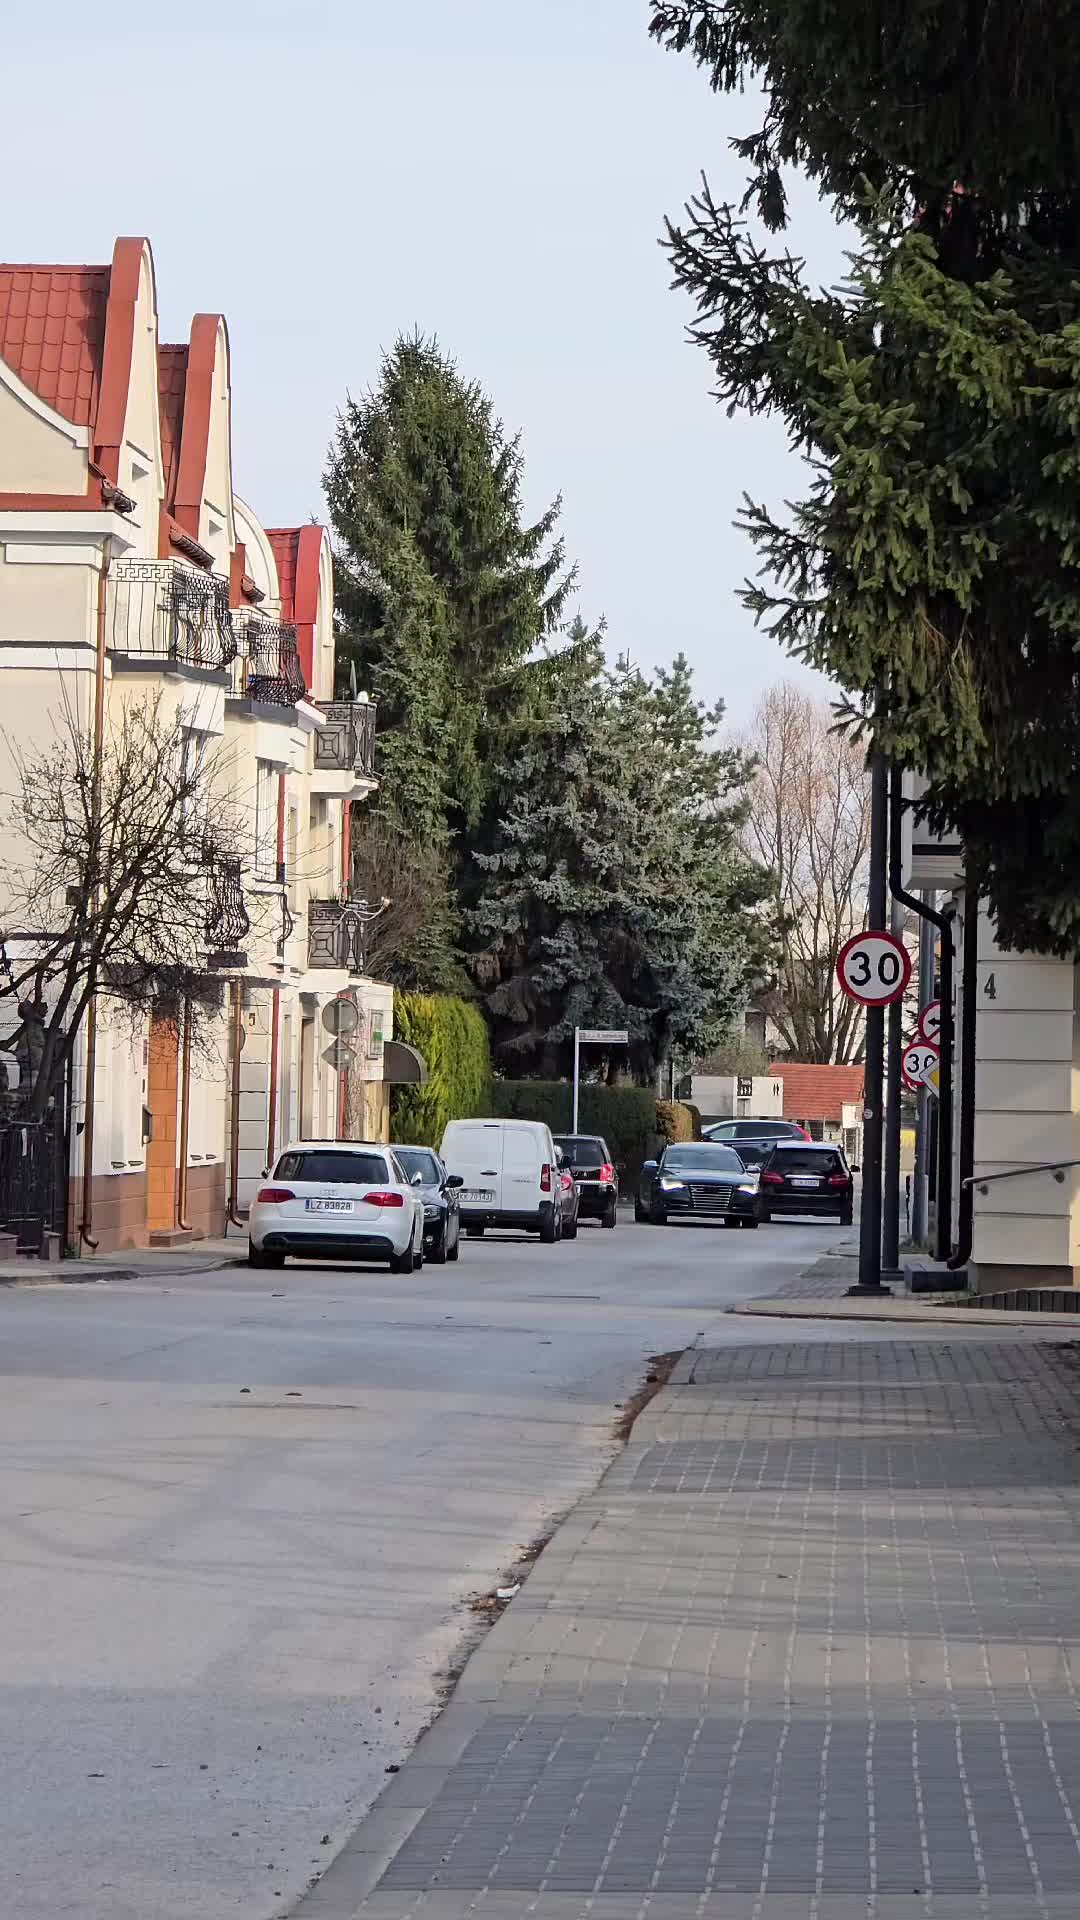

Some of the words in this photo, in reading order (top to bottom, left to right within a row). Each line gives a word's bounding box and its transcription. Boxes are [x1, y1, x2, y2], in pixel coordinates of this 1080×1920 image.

[850, 951, 900, 986] 30
[984, 973, 996, 999] 4
[249, 1013, 255, 1026] 5
[310, 1200, 322, 1210] LZ
